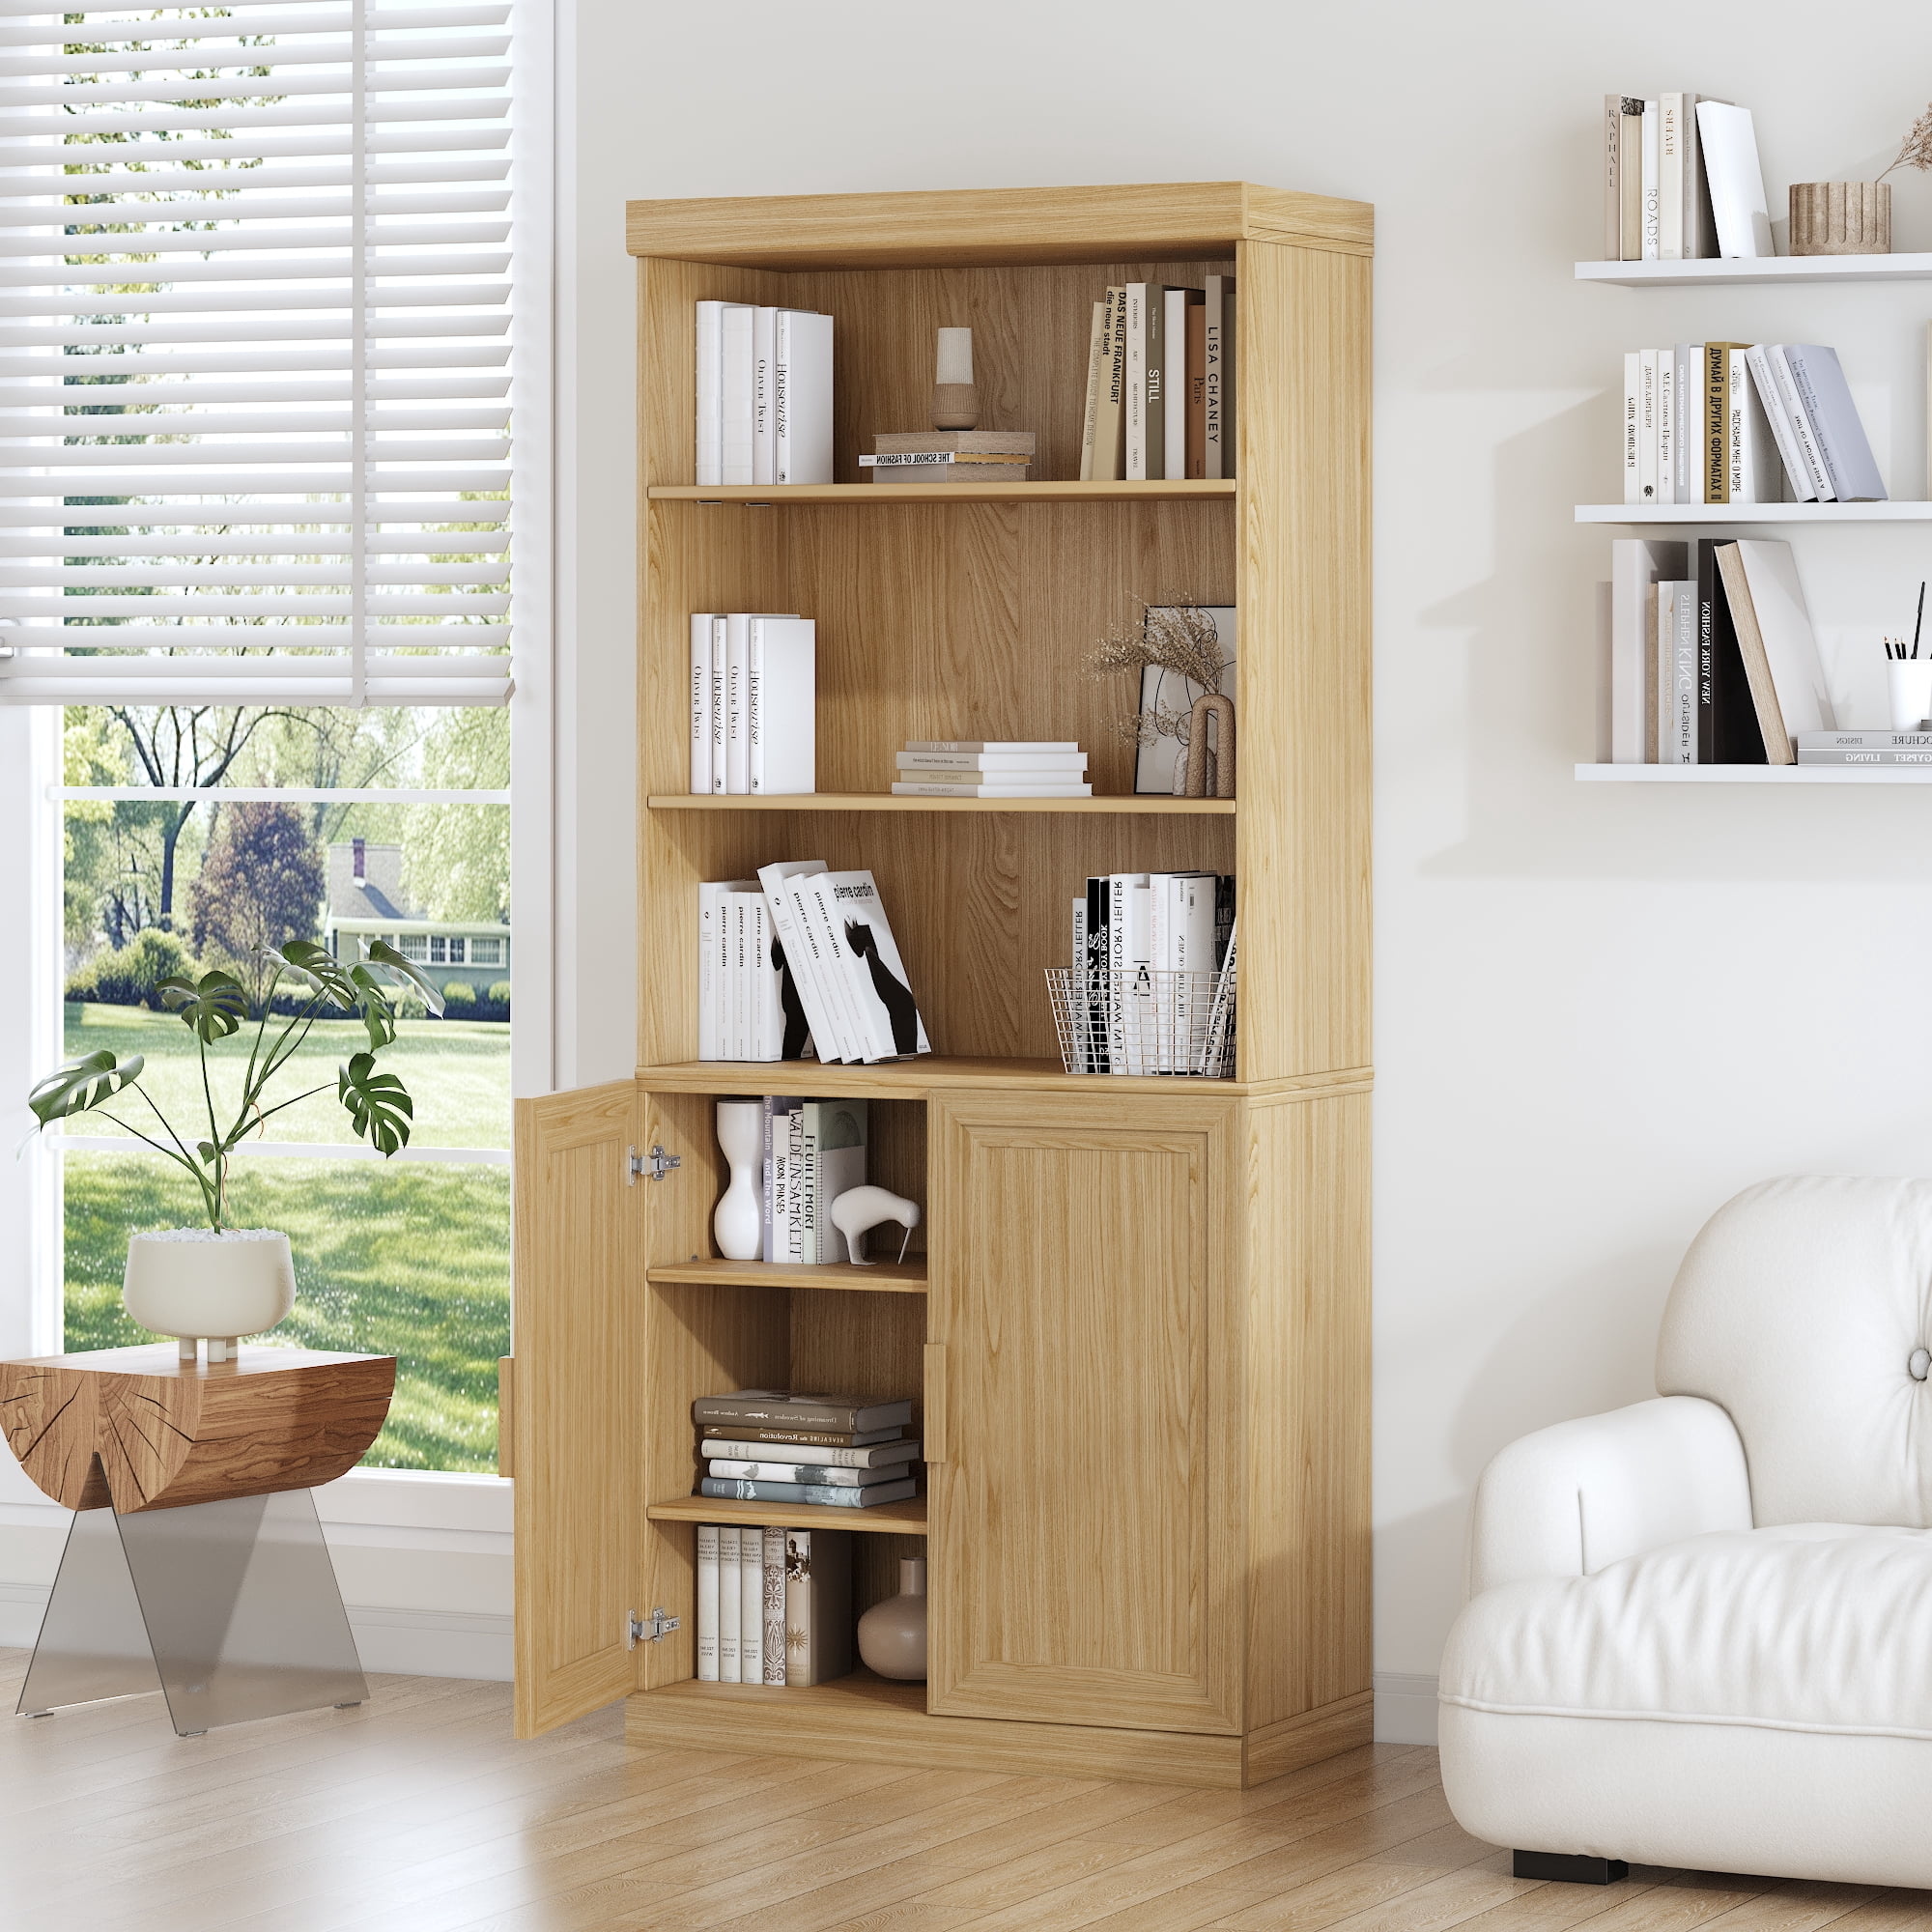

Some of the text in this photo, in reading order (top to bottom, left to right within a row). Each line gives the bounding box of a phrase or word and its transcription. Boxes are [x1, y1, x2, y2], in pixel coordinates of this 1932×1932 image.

[1665, 108, 1674, 156] RIVERS
[1647, 188, 1658, 245] ROADS
[1111, 292, 1126, 404] DAS NEUE FRANKFURT
[1710, 348, 1723, 384] ДУМАЙ
[777, 363, 787, 438] Housewise
[1149, 369, 1160, 403] STILL
[1194, 377, 1205, 405] Paris
[1208, 327, 1218, 443] LISA CHANEY
[1710, 395, 1721, 435] ДРУГИХ
[1732, 410, 1741, 446] РАССКАЖИ
[1794, 414, 1804, 429] TIME
[1800, 430, 1807, 440] OF
[1710, 438, 1721, 491] ФОРМАТАХ
[1732, 449, 1741, 464] МНЕ
[1804, 440, 1817, 466] HISTORY
[1732, 472, 1741, 493] МОРЕ
[713, 670, 724, 745] Housewise
[750, 670, 760, 745] Housewise
[793, 892, 808, 923] pierre
[807, 925, 819, 959] cardin
[814, 892, 829, 922] pierre
[828, 925, 840, 958] cardin
[776, 1155, 786, 1214] MOON PHASES
[789, 1111, 803, 1259] WALDEINSAMKEIT
[805, 1135, 815, 1232] FEUILLEMORT
